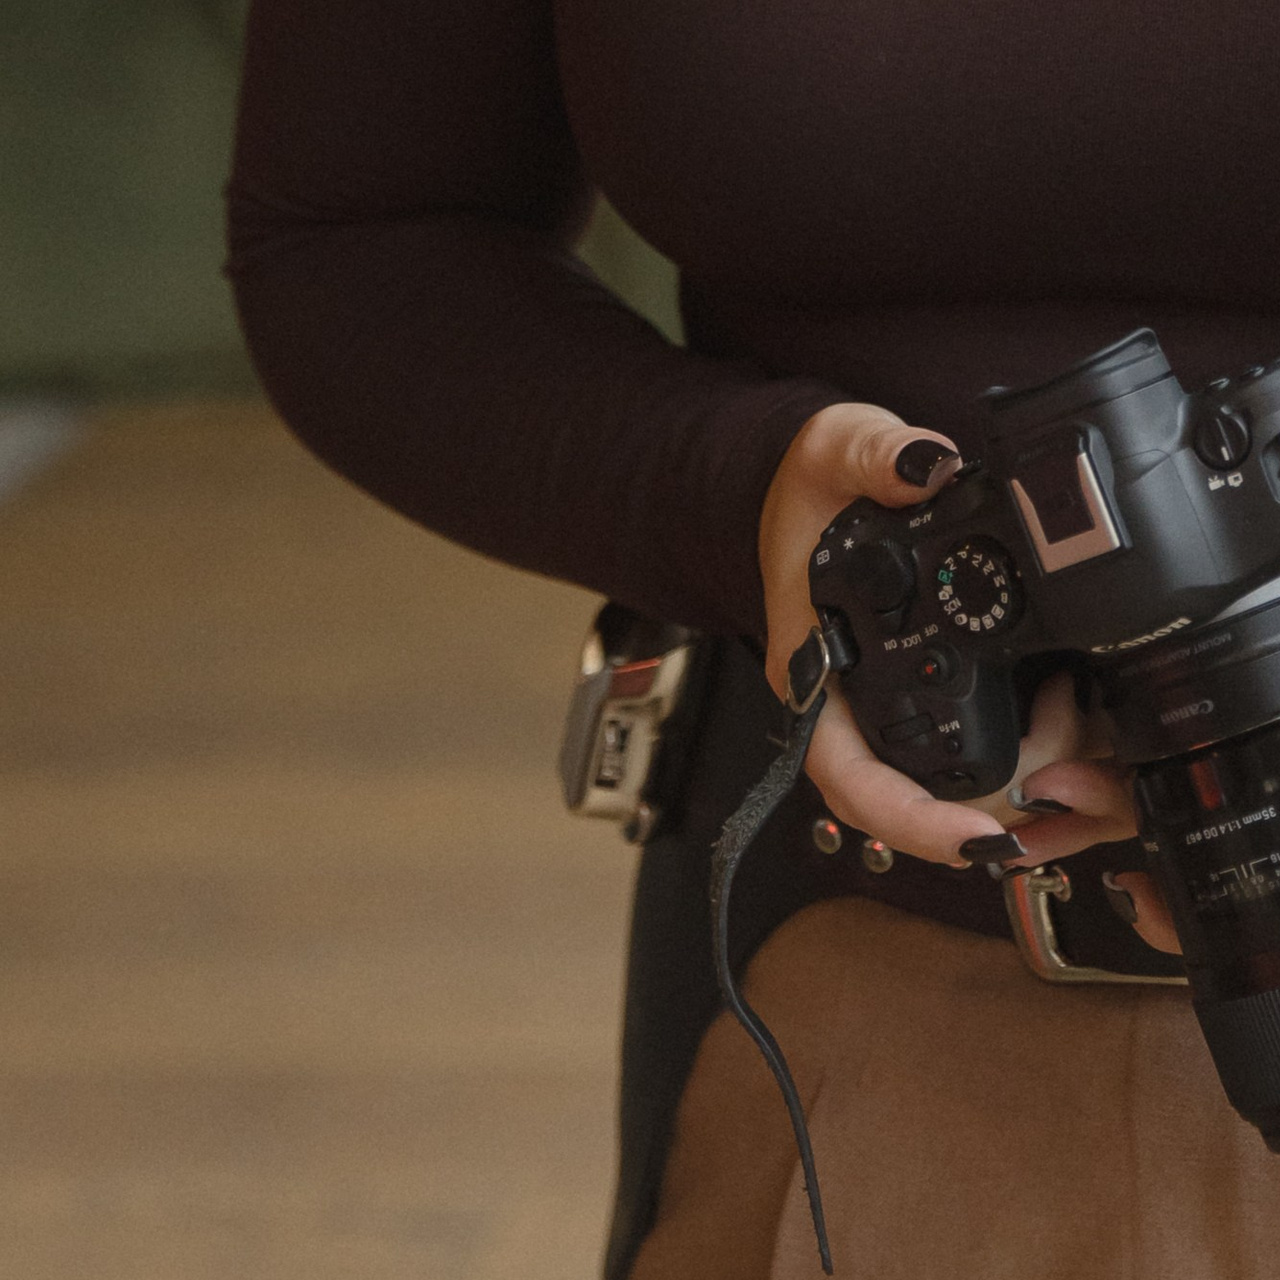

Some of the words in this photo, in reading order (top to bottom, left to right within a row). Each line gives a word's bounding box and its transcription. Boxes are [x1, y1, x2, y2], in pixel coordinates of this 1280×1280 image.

[993, 575, 1006, 588] M
[924, 623, 939, 638] OFF
[1091, 617, 1192, 653] Canon
[883, 638, 898, 651] ON
[901, 633, 922, 649] LOCK
[1193, 633, 1232, 655] MOUNT
[1160, 699, 1214, 726] Canon
[938, 720, 960, 734] M-Fn
[1242, 806, 1277, 825] 35mm
[1203, 826, 1219, 840] DG
[1220, 819, 1241, 835] 1:1.4
